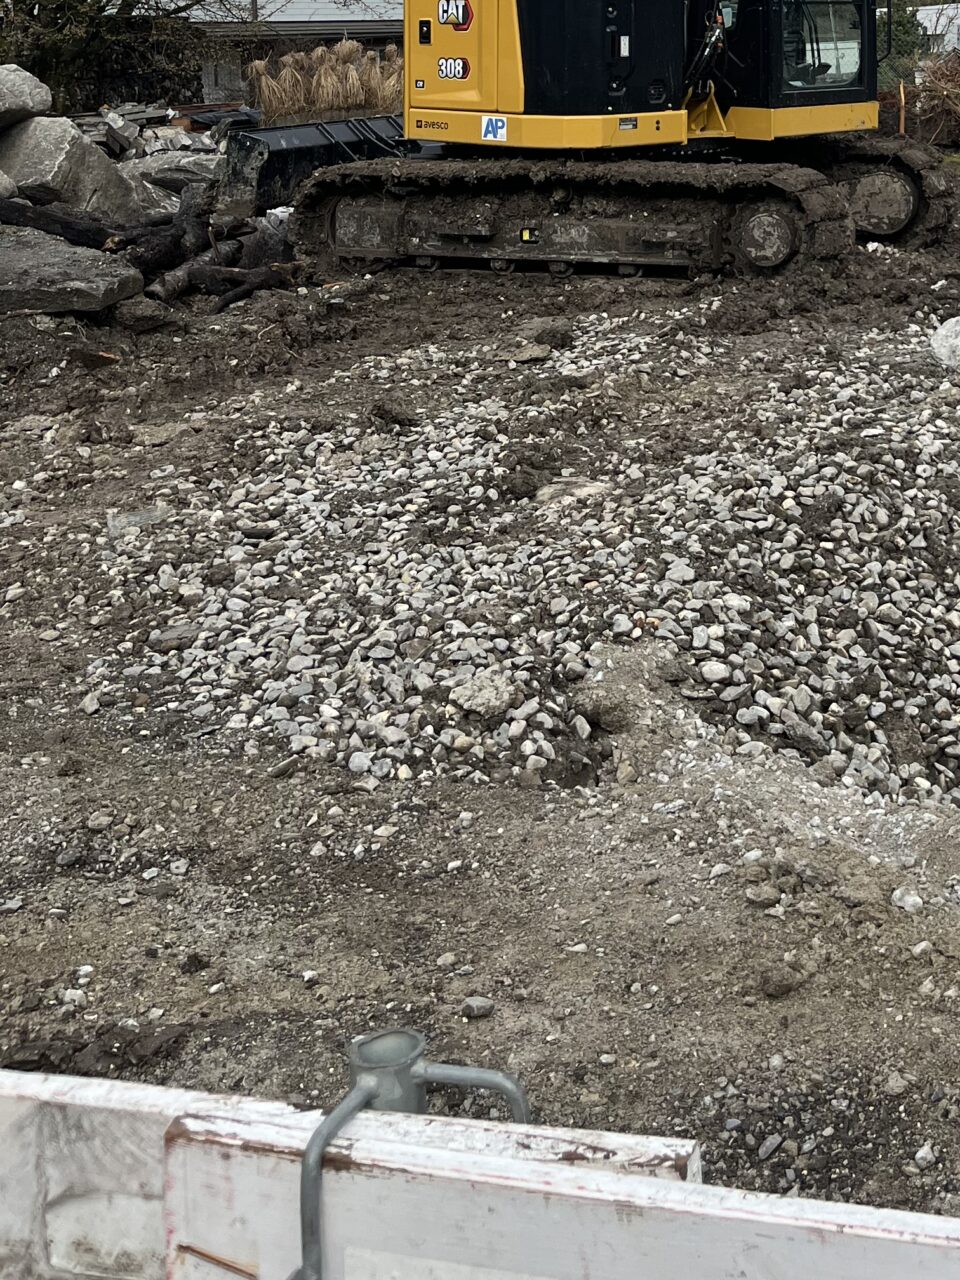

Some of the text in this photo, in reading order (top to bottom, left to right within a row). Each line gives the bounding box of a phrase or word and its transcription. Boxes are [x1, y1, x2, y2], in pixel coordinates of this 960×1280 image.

[438, 0, 466, 24] CAT
[438, 58, 464, 79] 308
[423, 121, 449, 130] avesco
[483, 118, 506, 139] AP
